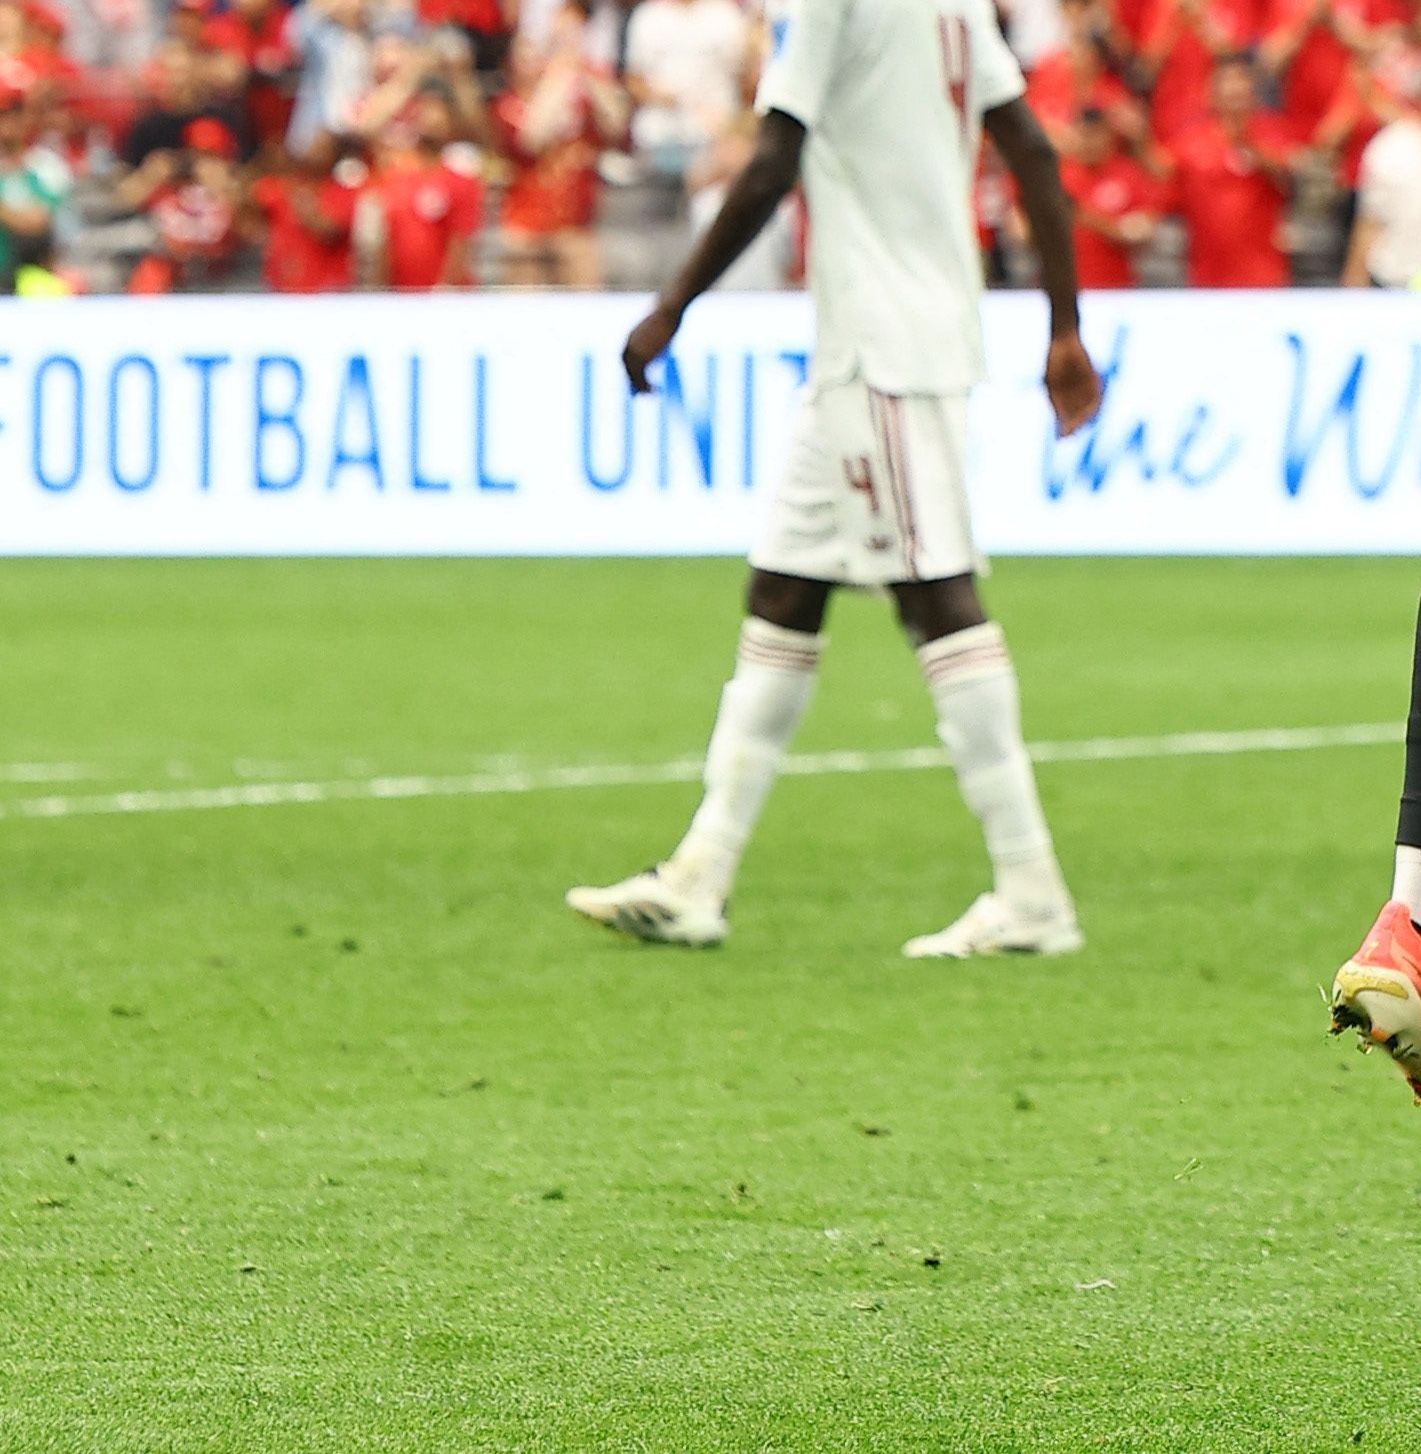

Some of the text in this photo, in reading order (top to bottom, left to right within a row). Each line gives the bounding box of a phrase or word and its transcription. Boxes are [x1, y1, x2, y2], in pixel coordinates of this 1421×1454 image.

[938, 12, 973, 144] 4
[0, 352, 517, 492] OOTBALL
[581, 352, 810, 492] UNI
[842, 454, 881, 514] 4
